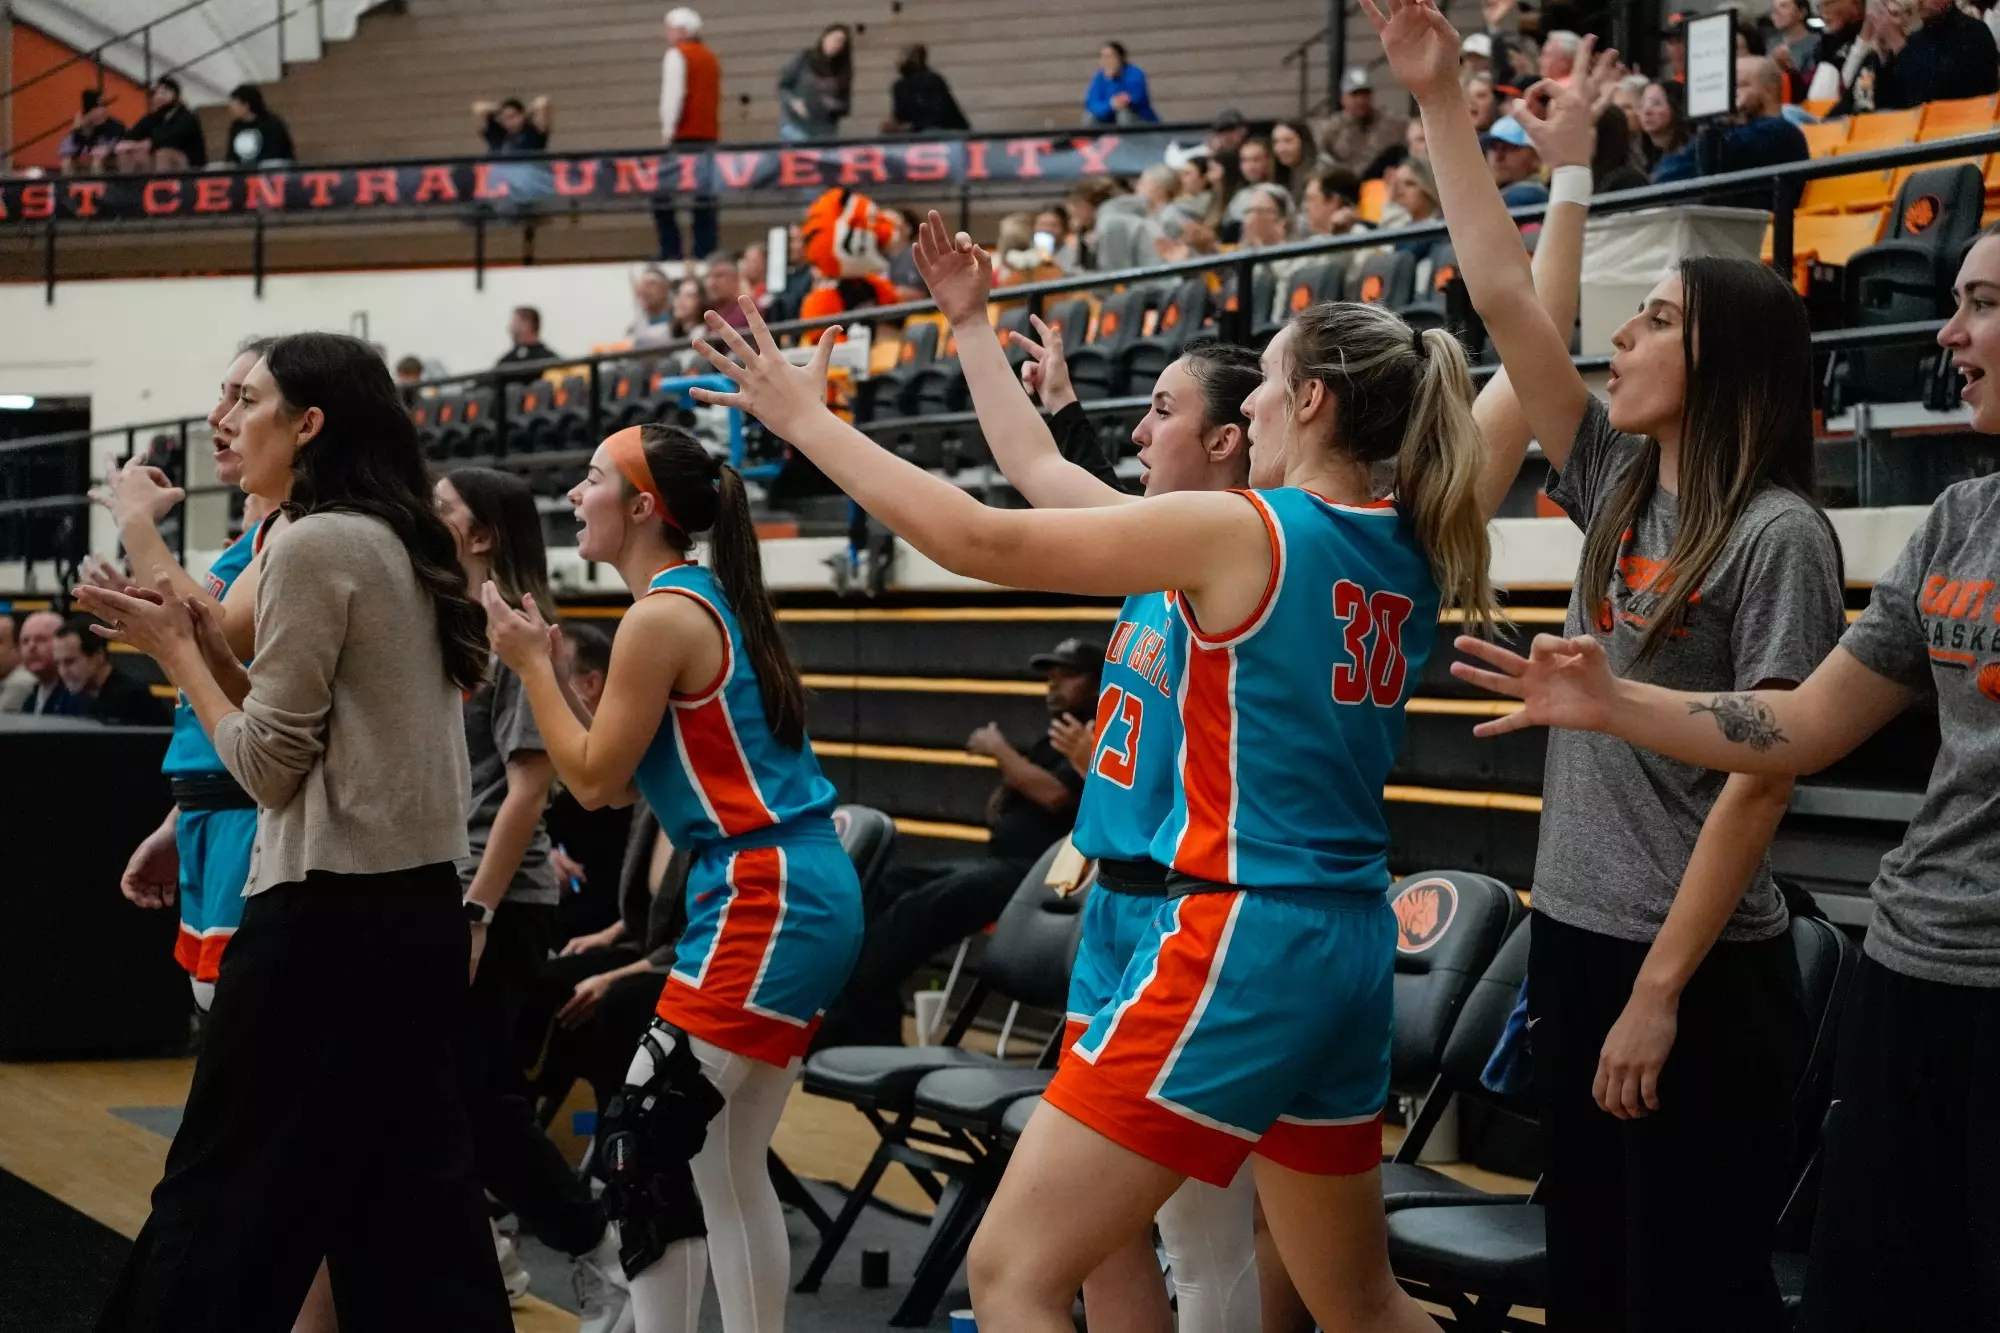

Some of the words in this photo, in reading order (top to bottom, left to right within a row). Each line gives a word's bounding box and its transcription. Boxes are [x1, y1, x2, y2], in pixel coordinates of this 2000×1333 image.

[0, 183, 105, 218] ST
[143, 162, 509, 215] CENTRAL
[551, 136, 1121, 196] UNIVERSITY
[1331, 578, 1414, 708] 30
[1091, 682, 1144, 790] 13
